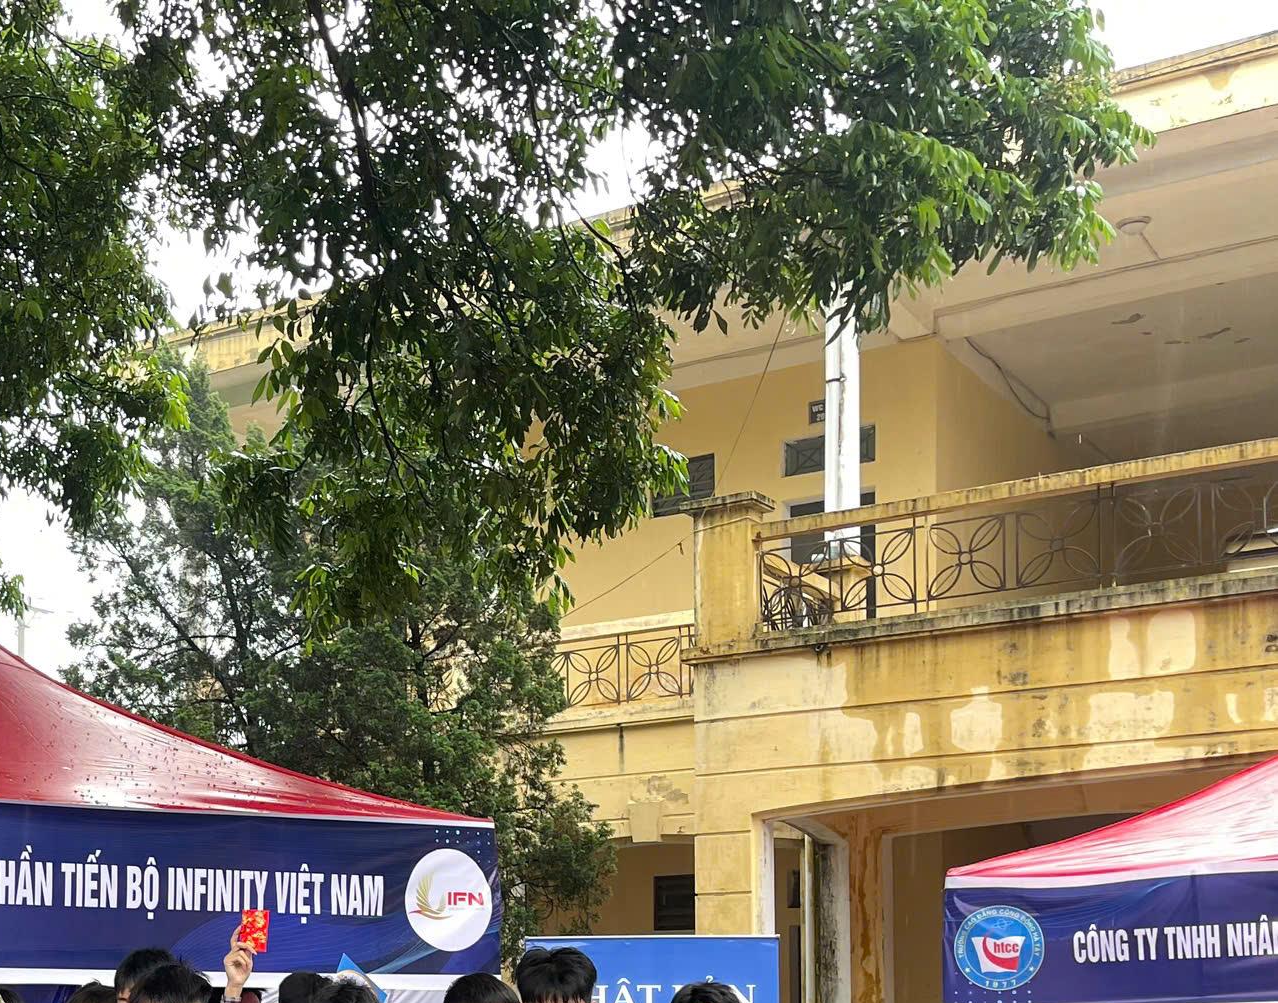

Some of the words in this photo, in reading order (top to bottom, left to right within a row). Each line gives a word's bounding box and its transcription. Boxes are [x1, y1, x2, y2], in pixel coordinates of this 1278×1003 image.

[60, 850, 118, 908] TIẾN
[126, 856, 160, 920] BỘ
[168, 866, 270, 912] INFINITY
[275, 864, 326, 924] VIỆT
[330, 873, 384, 917] NAM
[448, 892, 484, 906] IFN
[994, 942, 1019, 954] htcc
[1072, 924, 1130, 964] CÔNG
[1134, 927, 1158, 961] TY
[1164, 924, 1221, 960] TNHH
